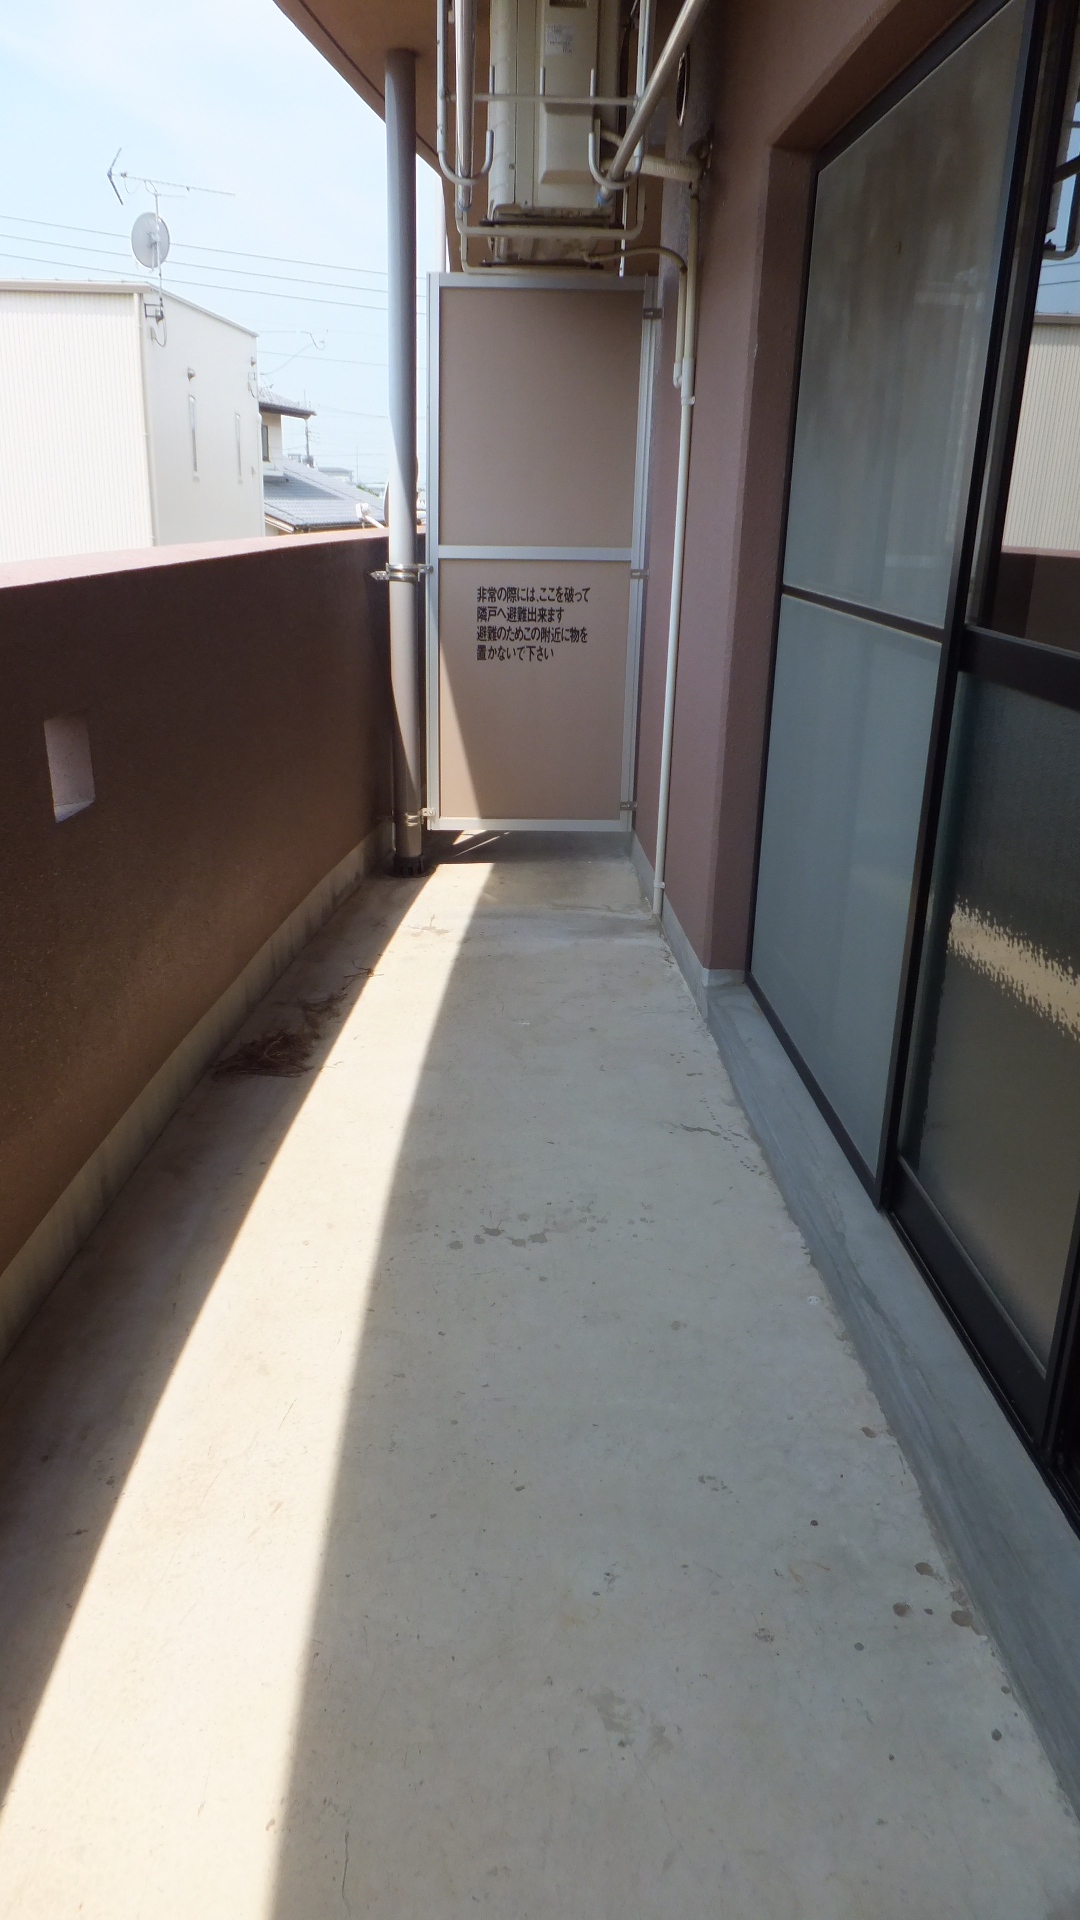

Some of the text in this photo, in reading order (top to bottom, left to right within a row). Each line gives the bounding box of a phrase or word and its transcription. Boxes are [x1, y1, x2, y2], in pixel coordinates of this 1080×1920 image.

[477, 606, 564, 623] 隣戸へ避難出来ます
[476, 625, 588, 643] 避難のためこの附近に物を
[477, 644, 554, 662] 置かないで下さい
